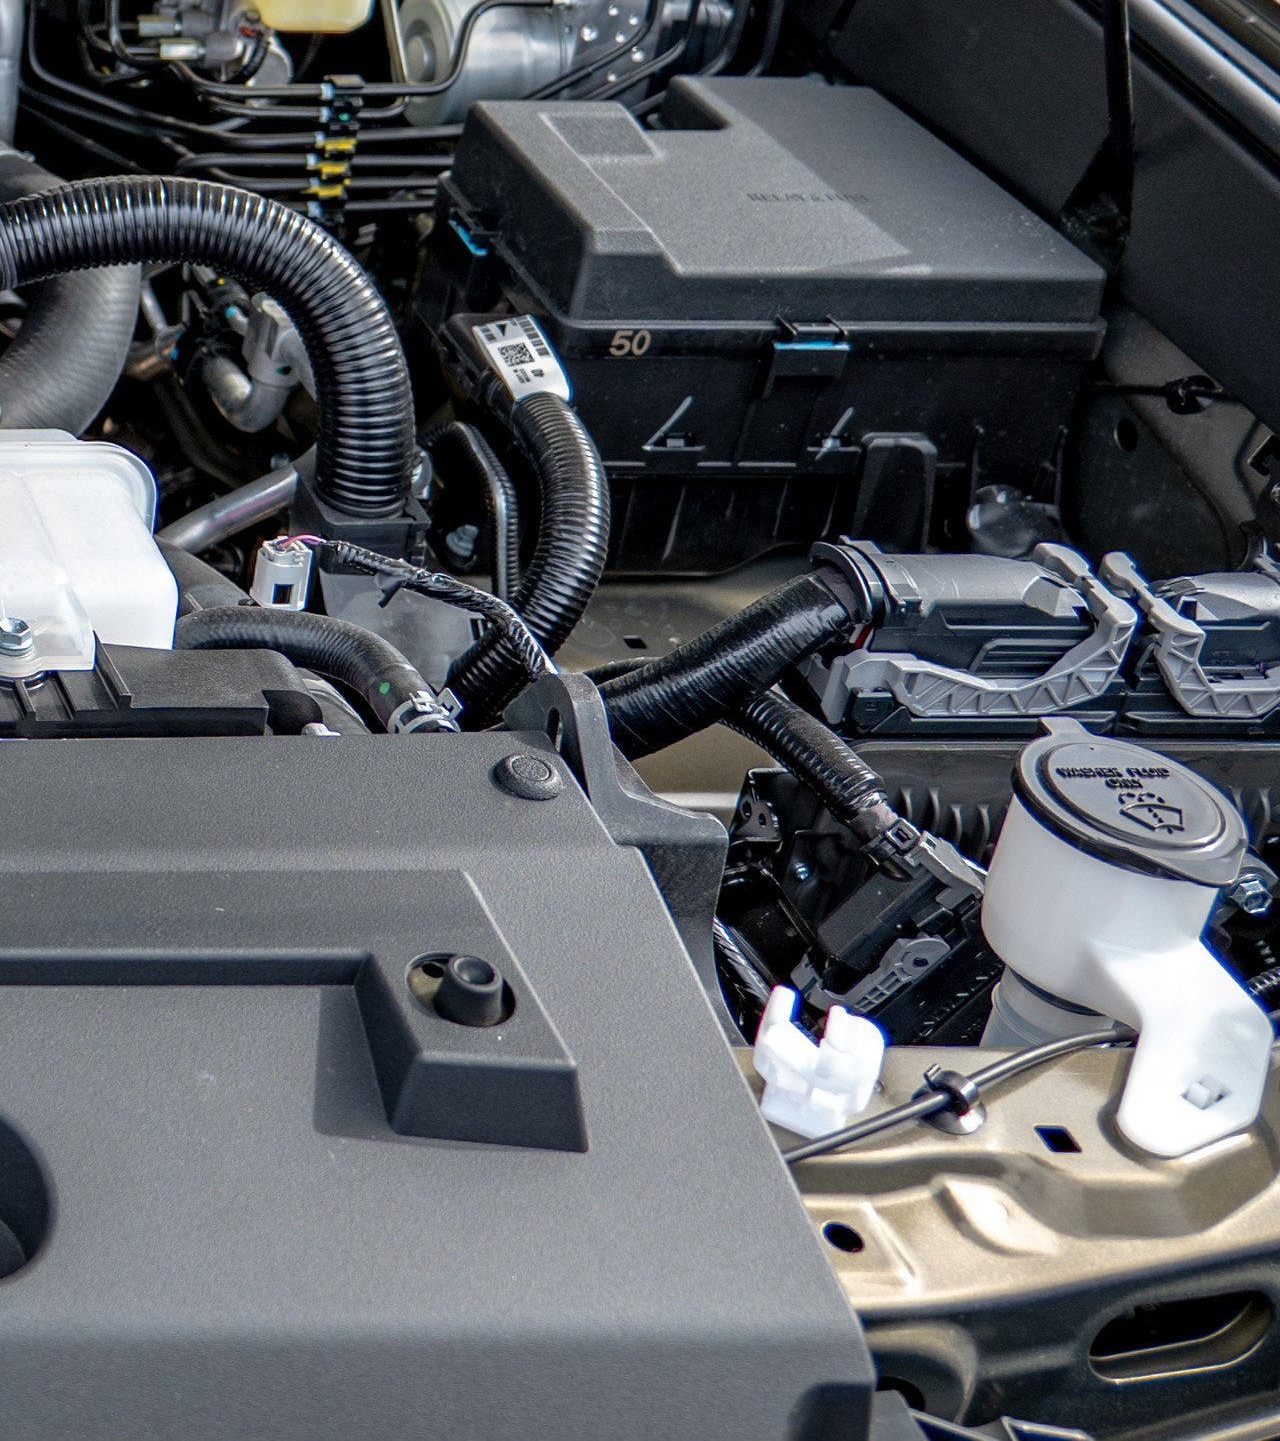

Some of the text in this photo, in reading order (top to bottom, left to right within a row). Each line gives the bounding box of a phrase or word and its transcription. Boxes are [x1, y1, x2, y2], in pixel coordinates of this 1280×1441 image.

[608, 329, 652, 356] 50
[1055, 767, 1171, 779] WASHER FLUID
[1104, 778, 1144, 789] ONLY
